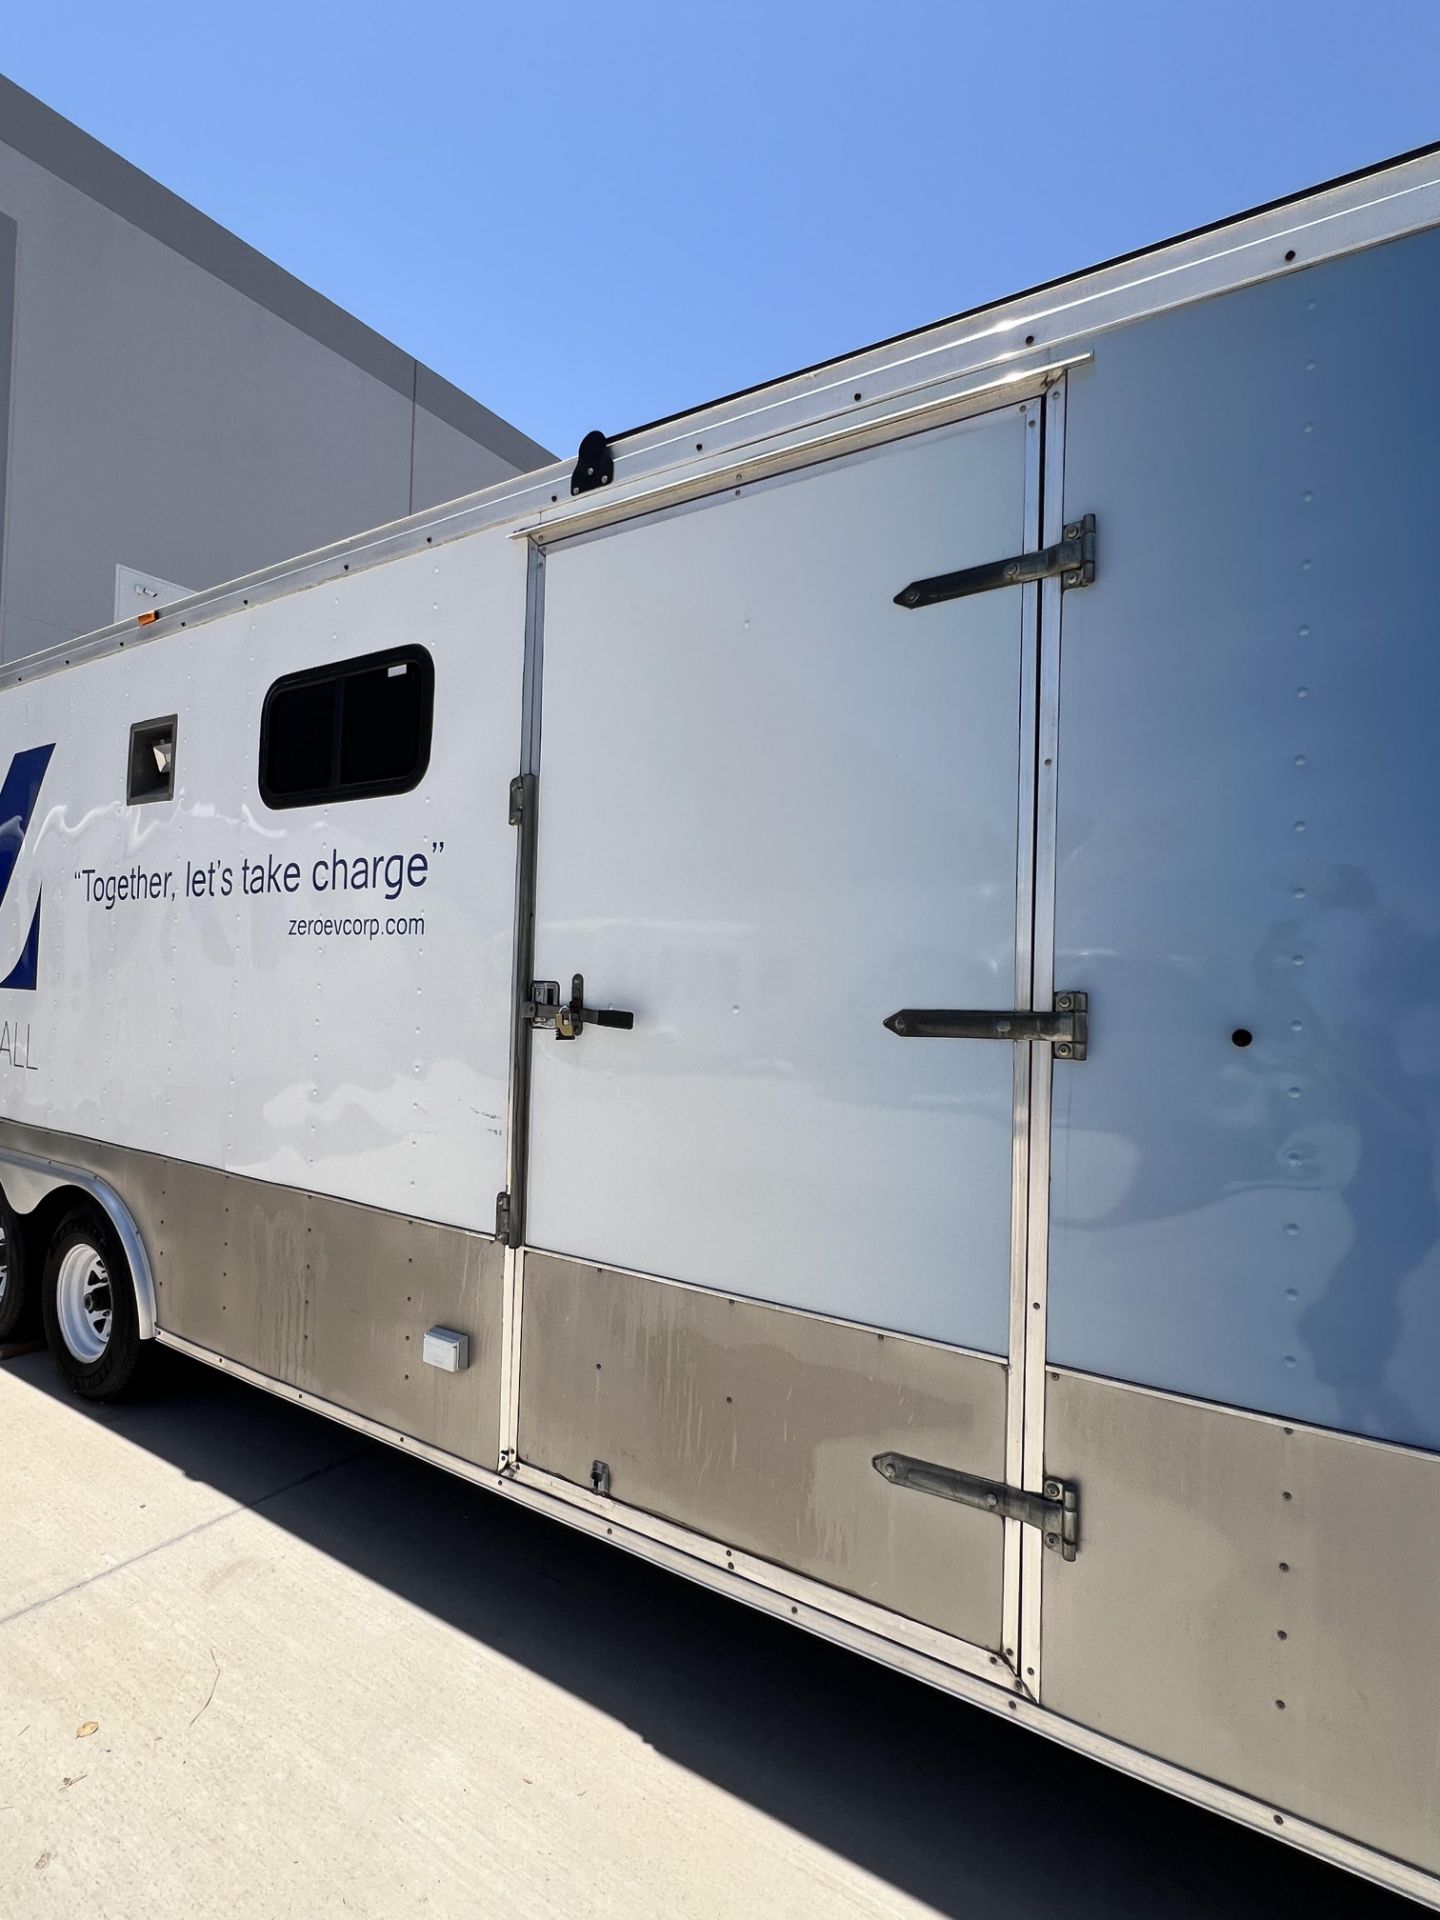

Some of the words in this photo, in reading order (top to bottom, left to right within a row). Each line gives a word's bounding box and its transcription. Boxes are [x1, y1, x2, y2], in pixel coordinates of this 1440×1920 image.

[74, 865, 176, 910] “Together,
[185, 860, 233, 897] let’s
[242, 854, 301, 895] take
[312, 842, 444, 900] charge”
[288, 917, 425, 940] zeroevcorp.com
[0, 1020, 38, 1070] ALL
